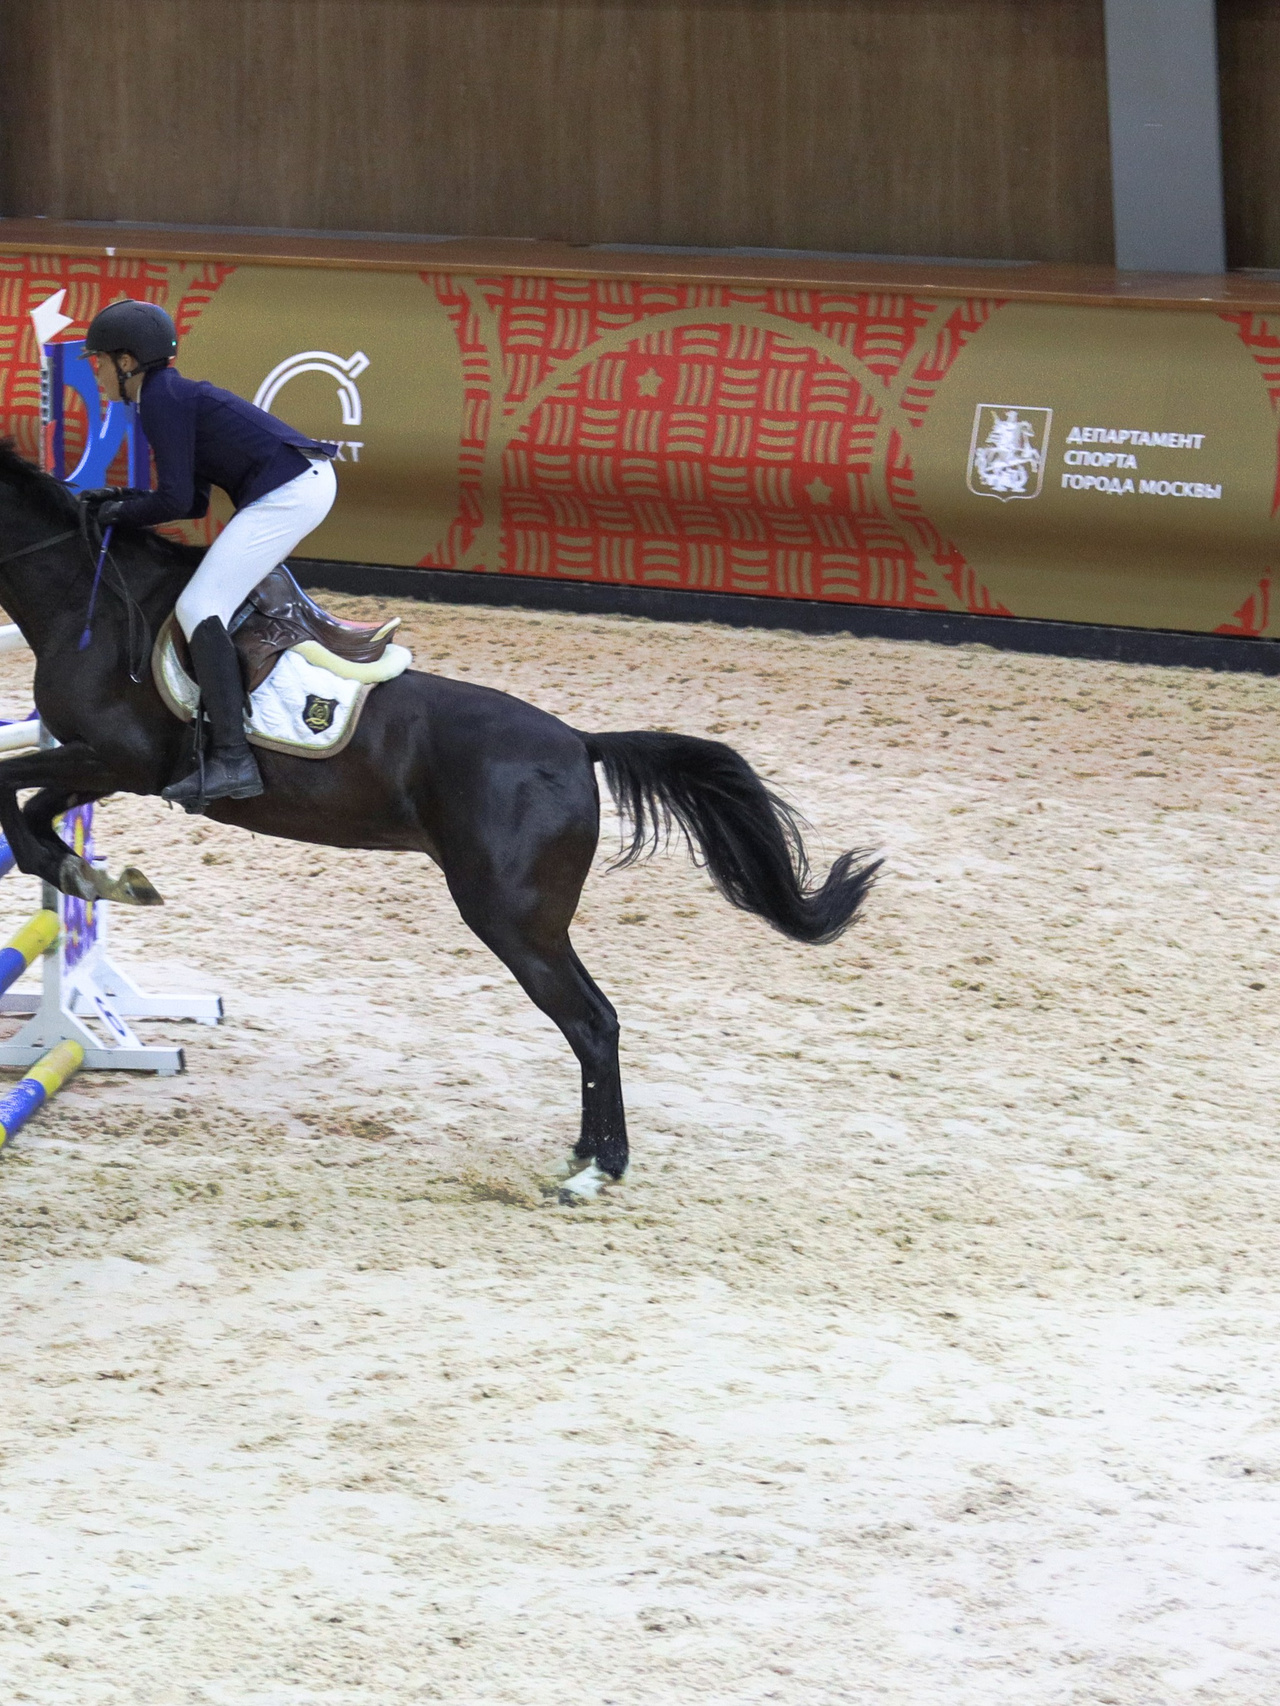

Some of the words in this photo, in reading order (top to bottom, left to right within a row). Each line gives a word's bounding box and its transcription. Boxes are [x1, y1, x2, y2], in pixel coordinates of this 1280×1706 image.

[1066, 426, 1205, 449] ДЕПАРТАМЕНТ
[1063, 450, 1138, 469] СПОРТА
[1061, 473, 1135, 495] ГОРОДА
[1139, 479, 1222, 499] МОСКВЫ
